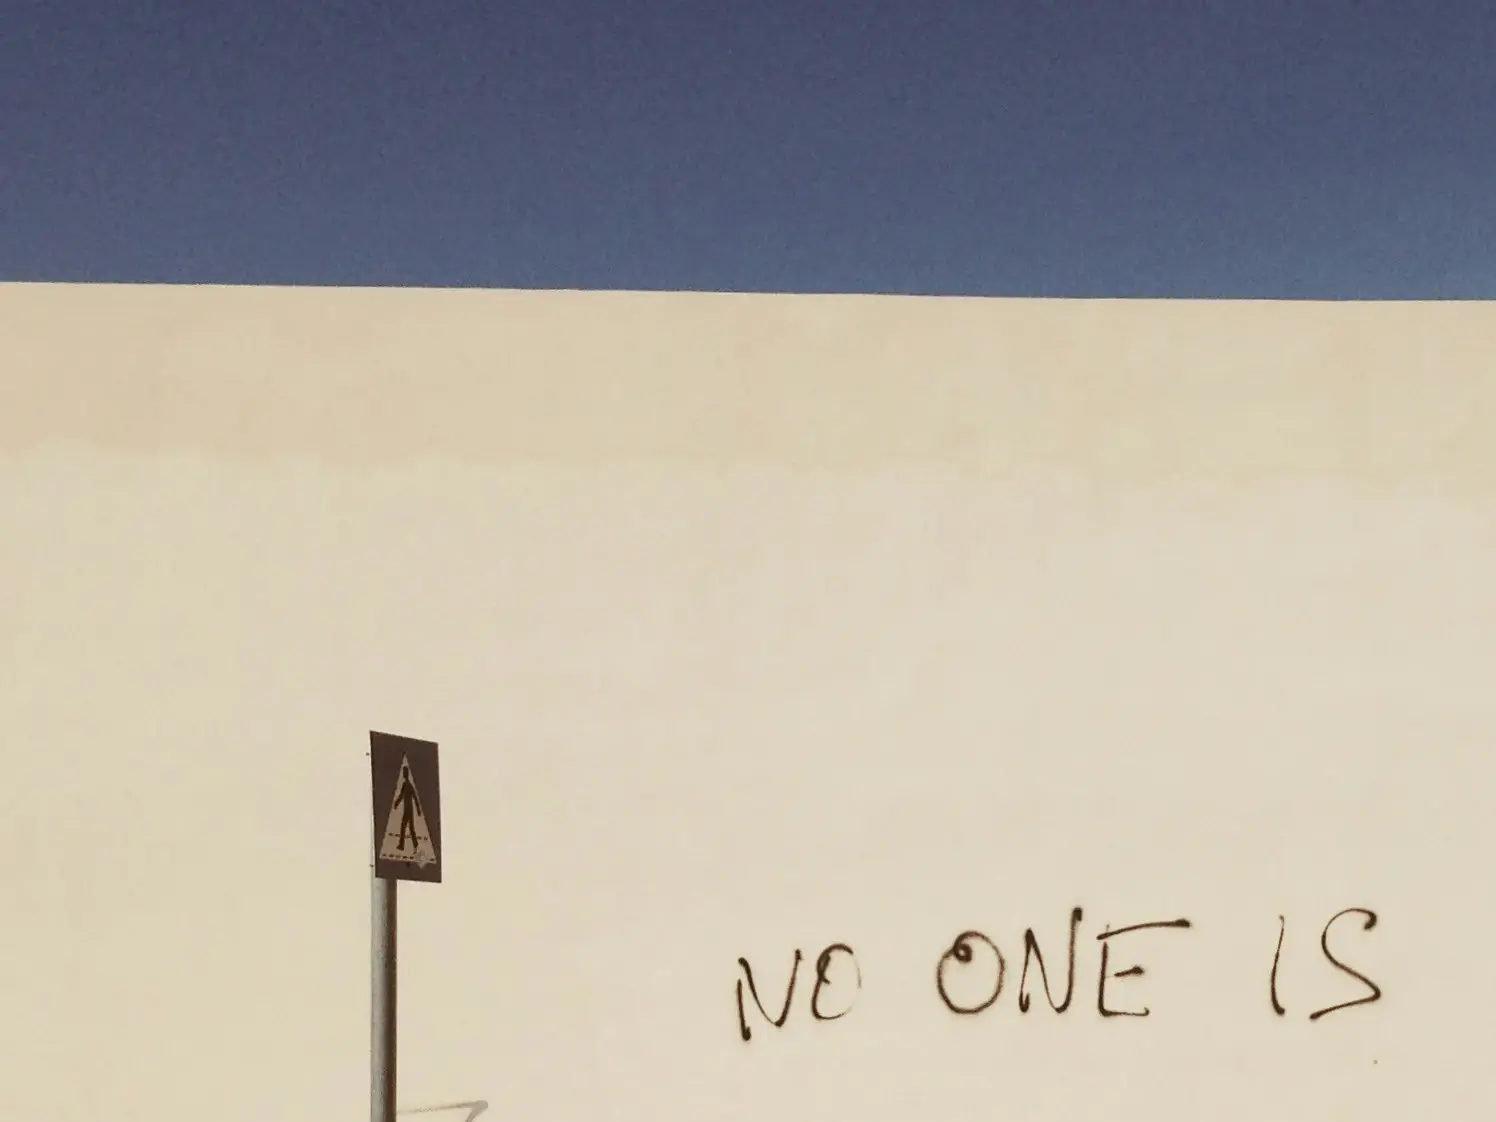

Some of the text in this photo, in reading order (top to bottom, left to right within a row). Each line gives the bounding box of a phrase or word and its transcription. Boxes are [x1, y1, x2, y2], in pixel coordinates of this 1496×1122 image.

[734, 942, 862, 1044] NO
[934, 905, 1194, 1019] ONE
[1268, 906, 1383, 1022] IS
